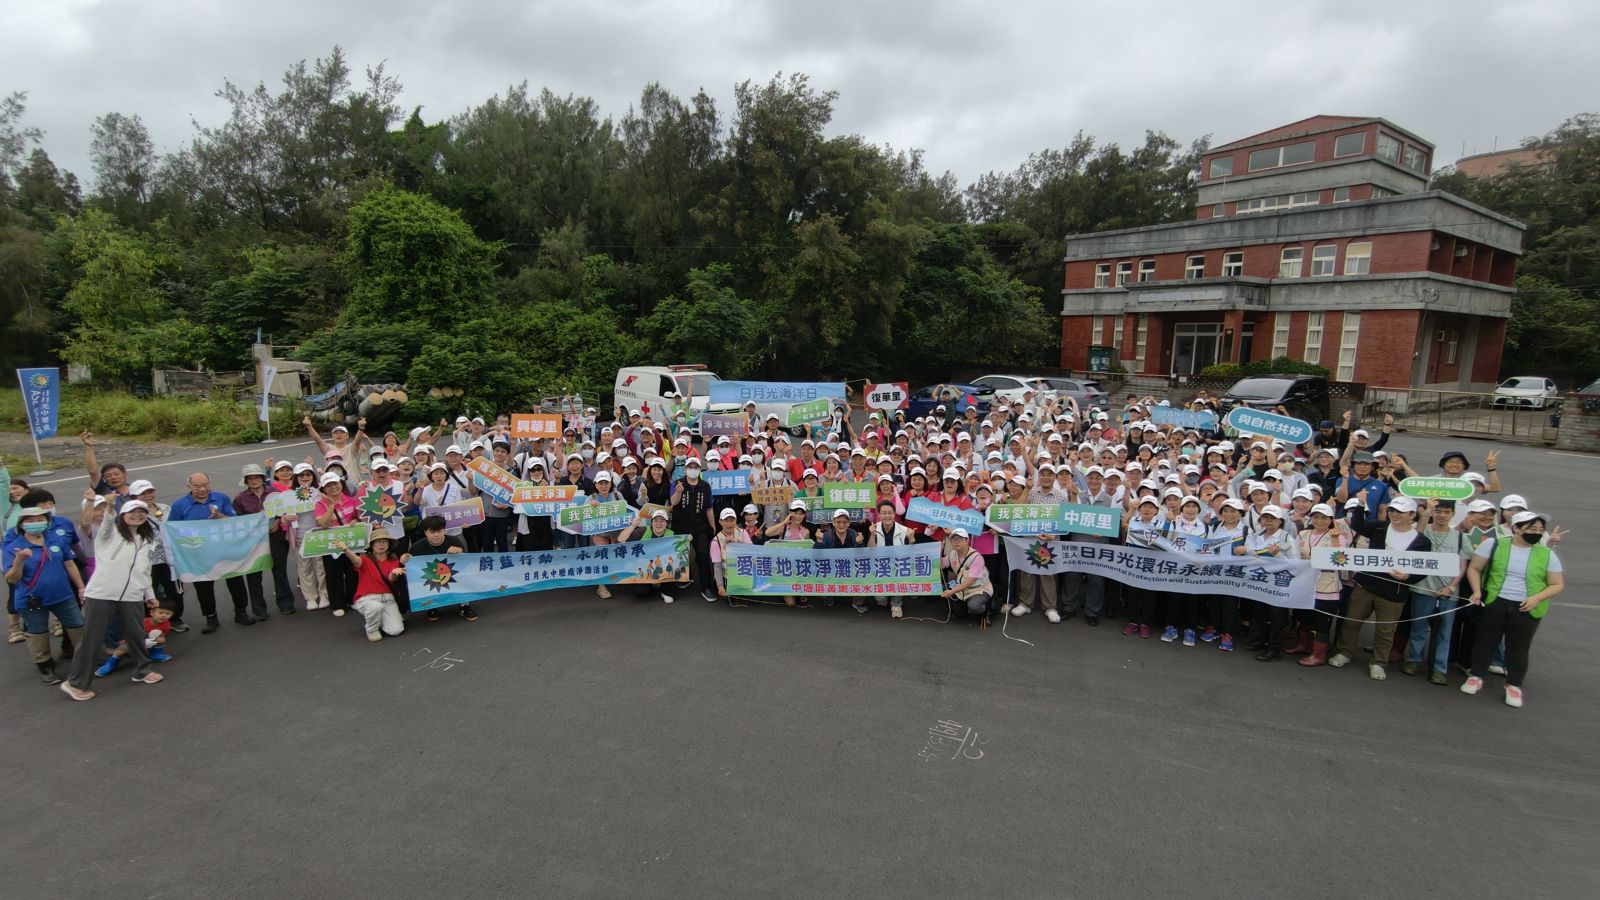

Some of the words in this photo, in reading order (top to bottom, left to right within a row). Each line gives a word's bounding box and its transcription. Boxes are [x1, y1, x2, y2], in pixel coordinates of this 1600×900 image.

[740, 387, 817, 399] 日月光海洋日
[871, 391, 902, 403] 復華里
[516, 419, 558, 433] 興華里
[1237, 413, 1303, 438] 與自然共好
[707, 474, 747, 490] 復興里
[521, 488, 566, 500] 攜手淨灘
[829, 488, 871, 503] 復華里
[1418, 489, 1453, 497] ASECL
[440, 507, 480, 521] 海愛地球
[568, 504, 620, 523] 我愛海洋
[931, 509, 979, 526] 日月光海洋日
[997, 506, 1053, 520] 我愛海洋
[1064, 510, 1113, 530] 中原里
[583, 514, 633, 531] 珍惜地球
[736, 555, 932, 579] 愛護地球淨灘淨溪活動
[1080, 546, 1296, 588] 日月光環保永續基金會
[1353, 555, 1395, 567] 日月光
[1398, 557, 1439, 570] 中壢廠
[1077, 560, 1128, 575] Environmental
[1128, 571, 1168, 583] Protection
[1185, 578, 1241, 588] Sustainability
[1241, 582, 1290, 598] Foundation
